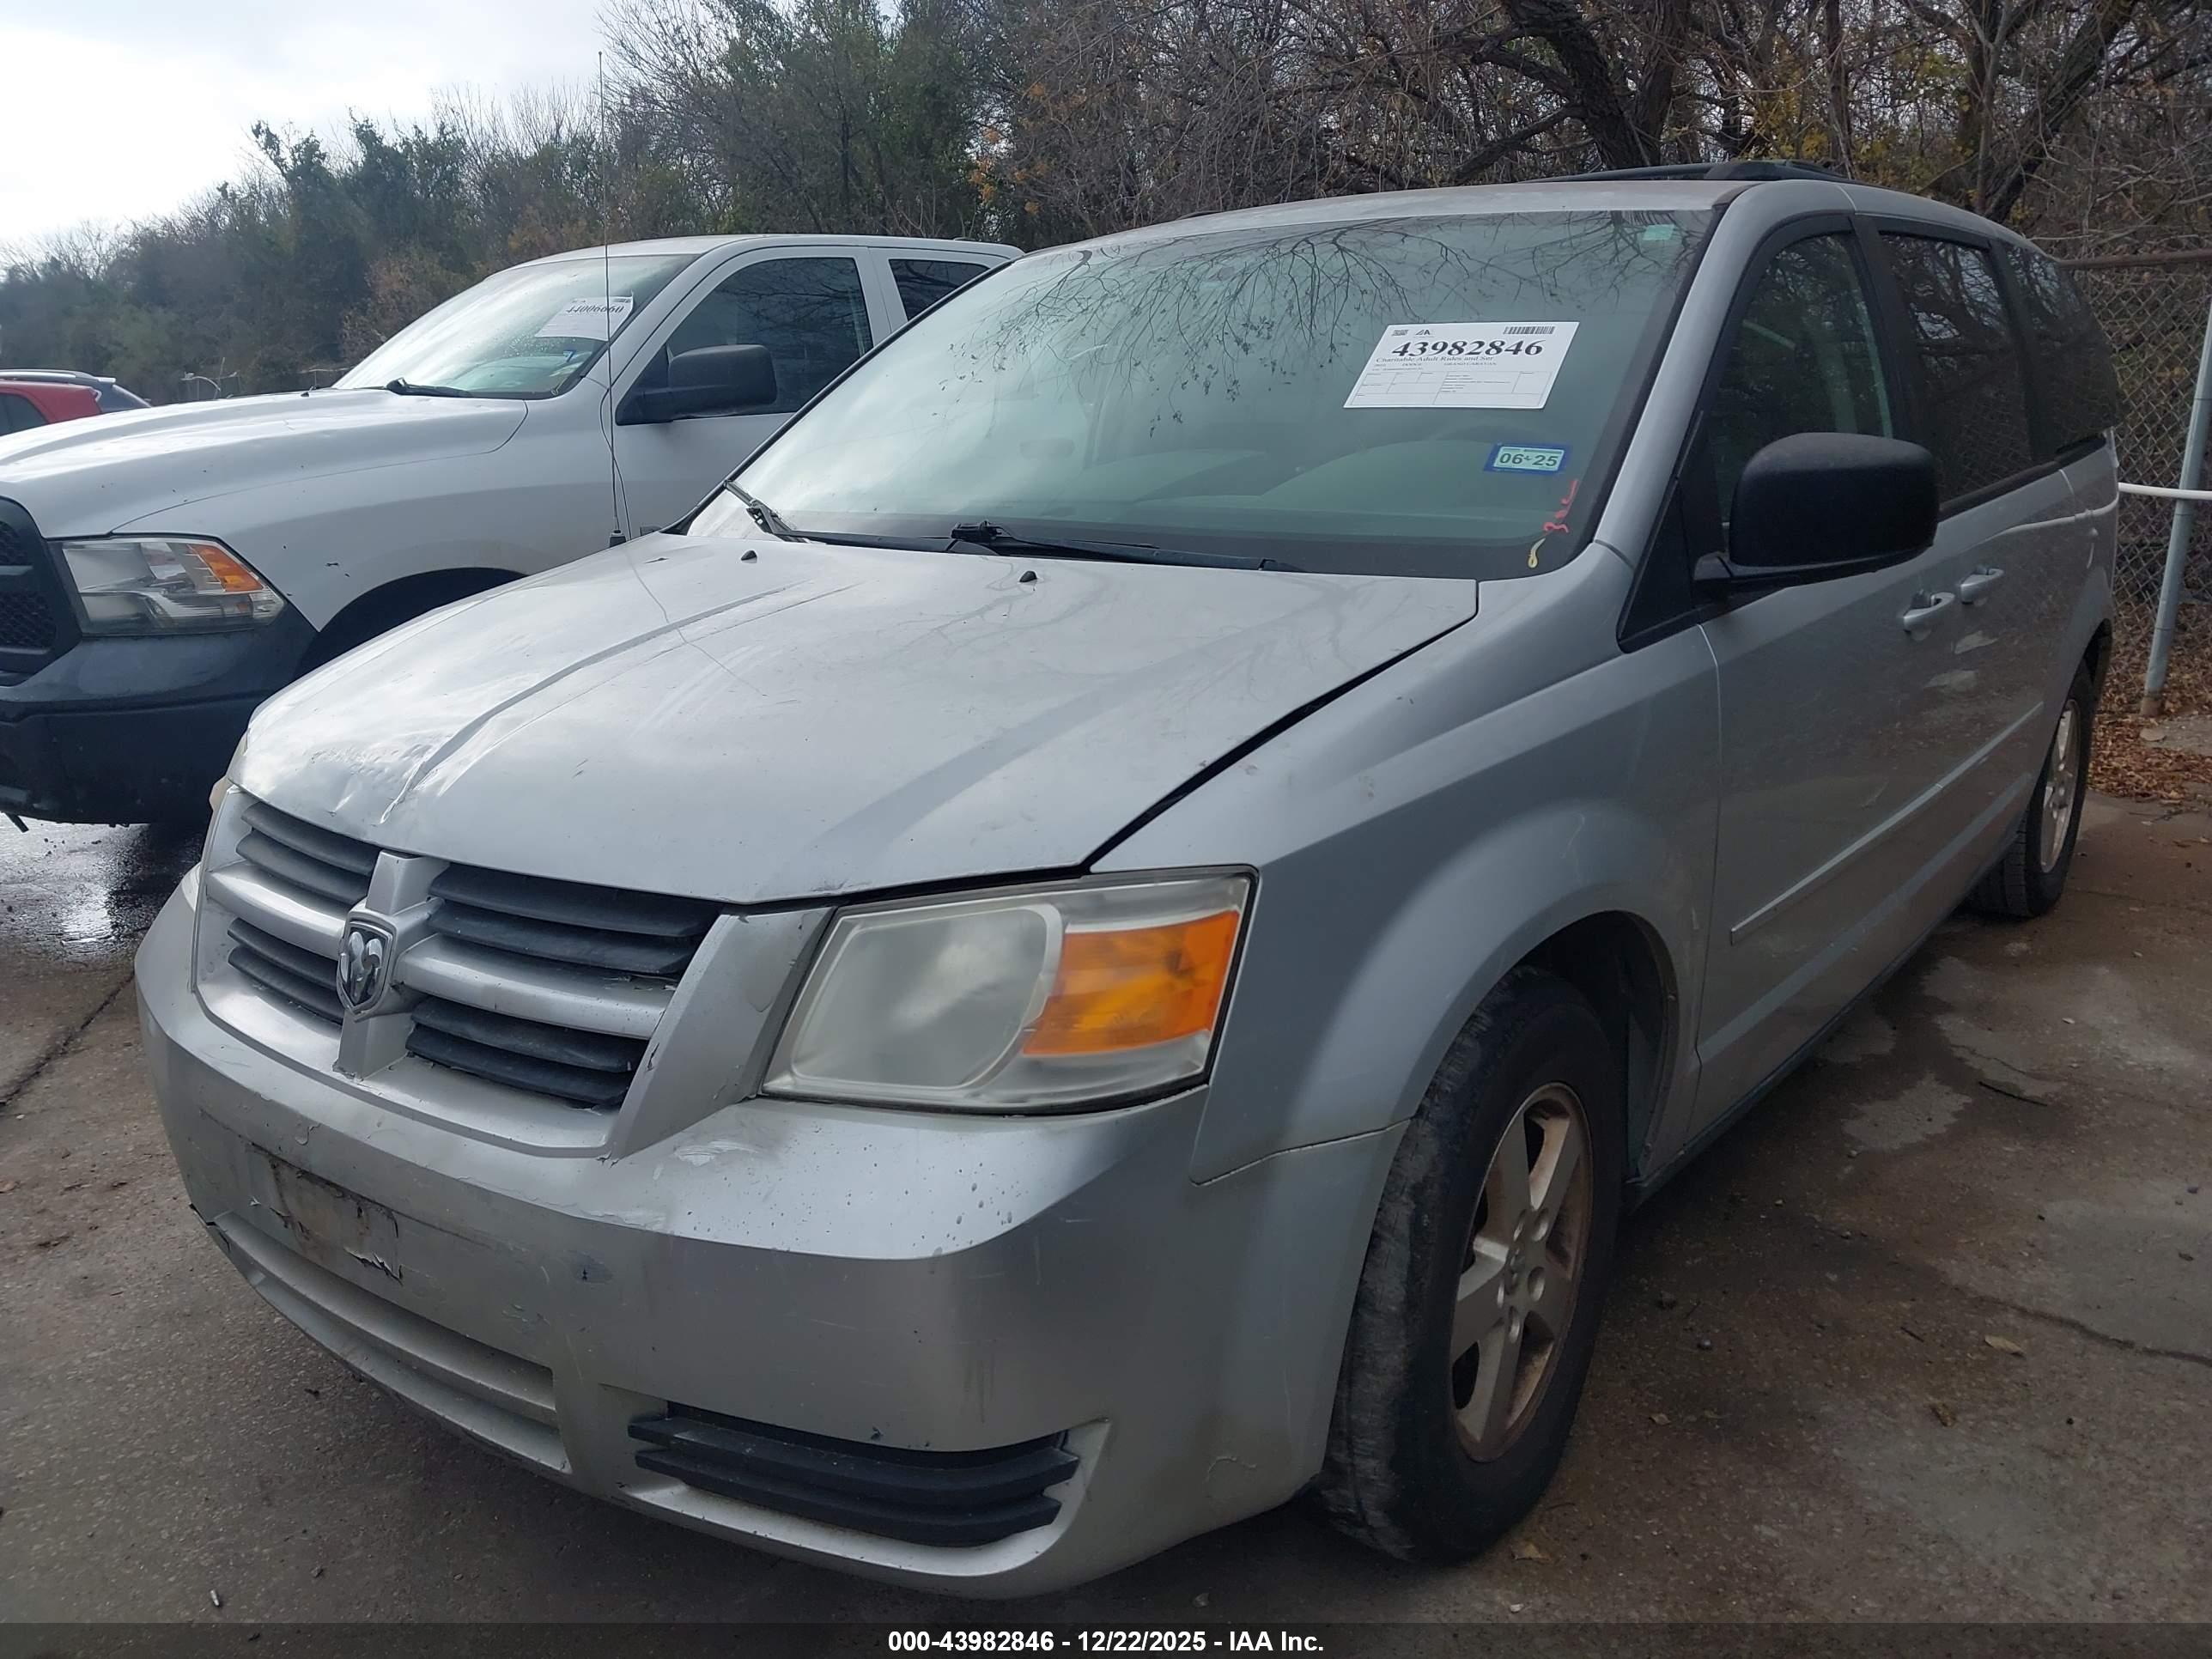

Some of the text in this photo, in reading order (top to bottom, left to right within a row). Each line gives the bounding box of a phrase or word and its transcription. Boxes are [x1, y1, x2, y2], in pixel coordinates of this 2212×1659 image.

[1391, 339, 1546, 356] 43982846
[1499, 453, 1559, 466] 06 25
